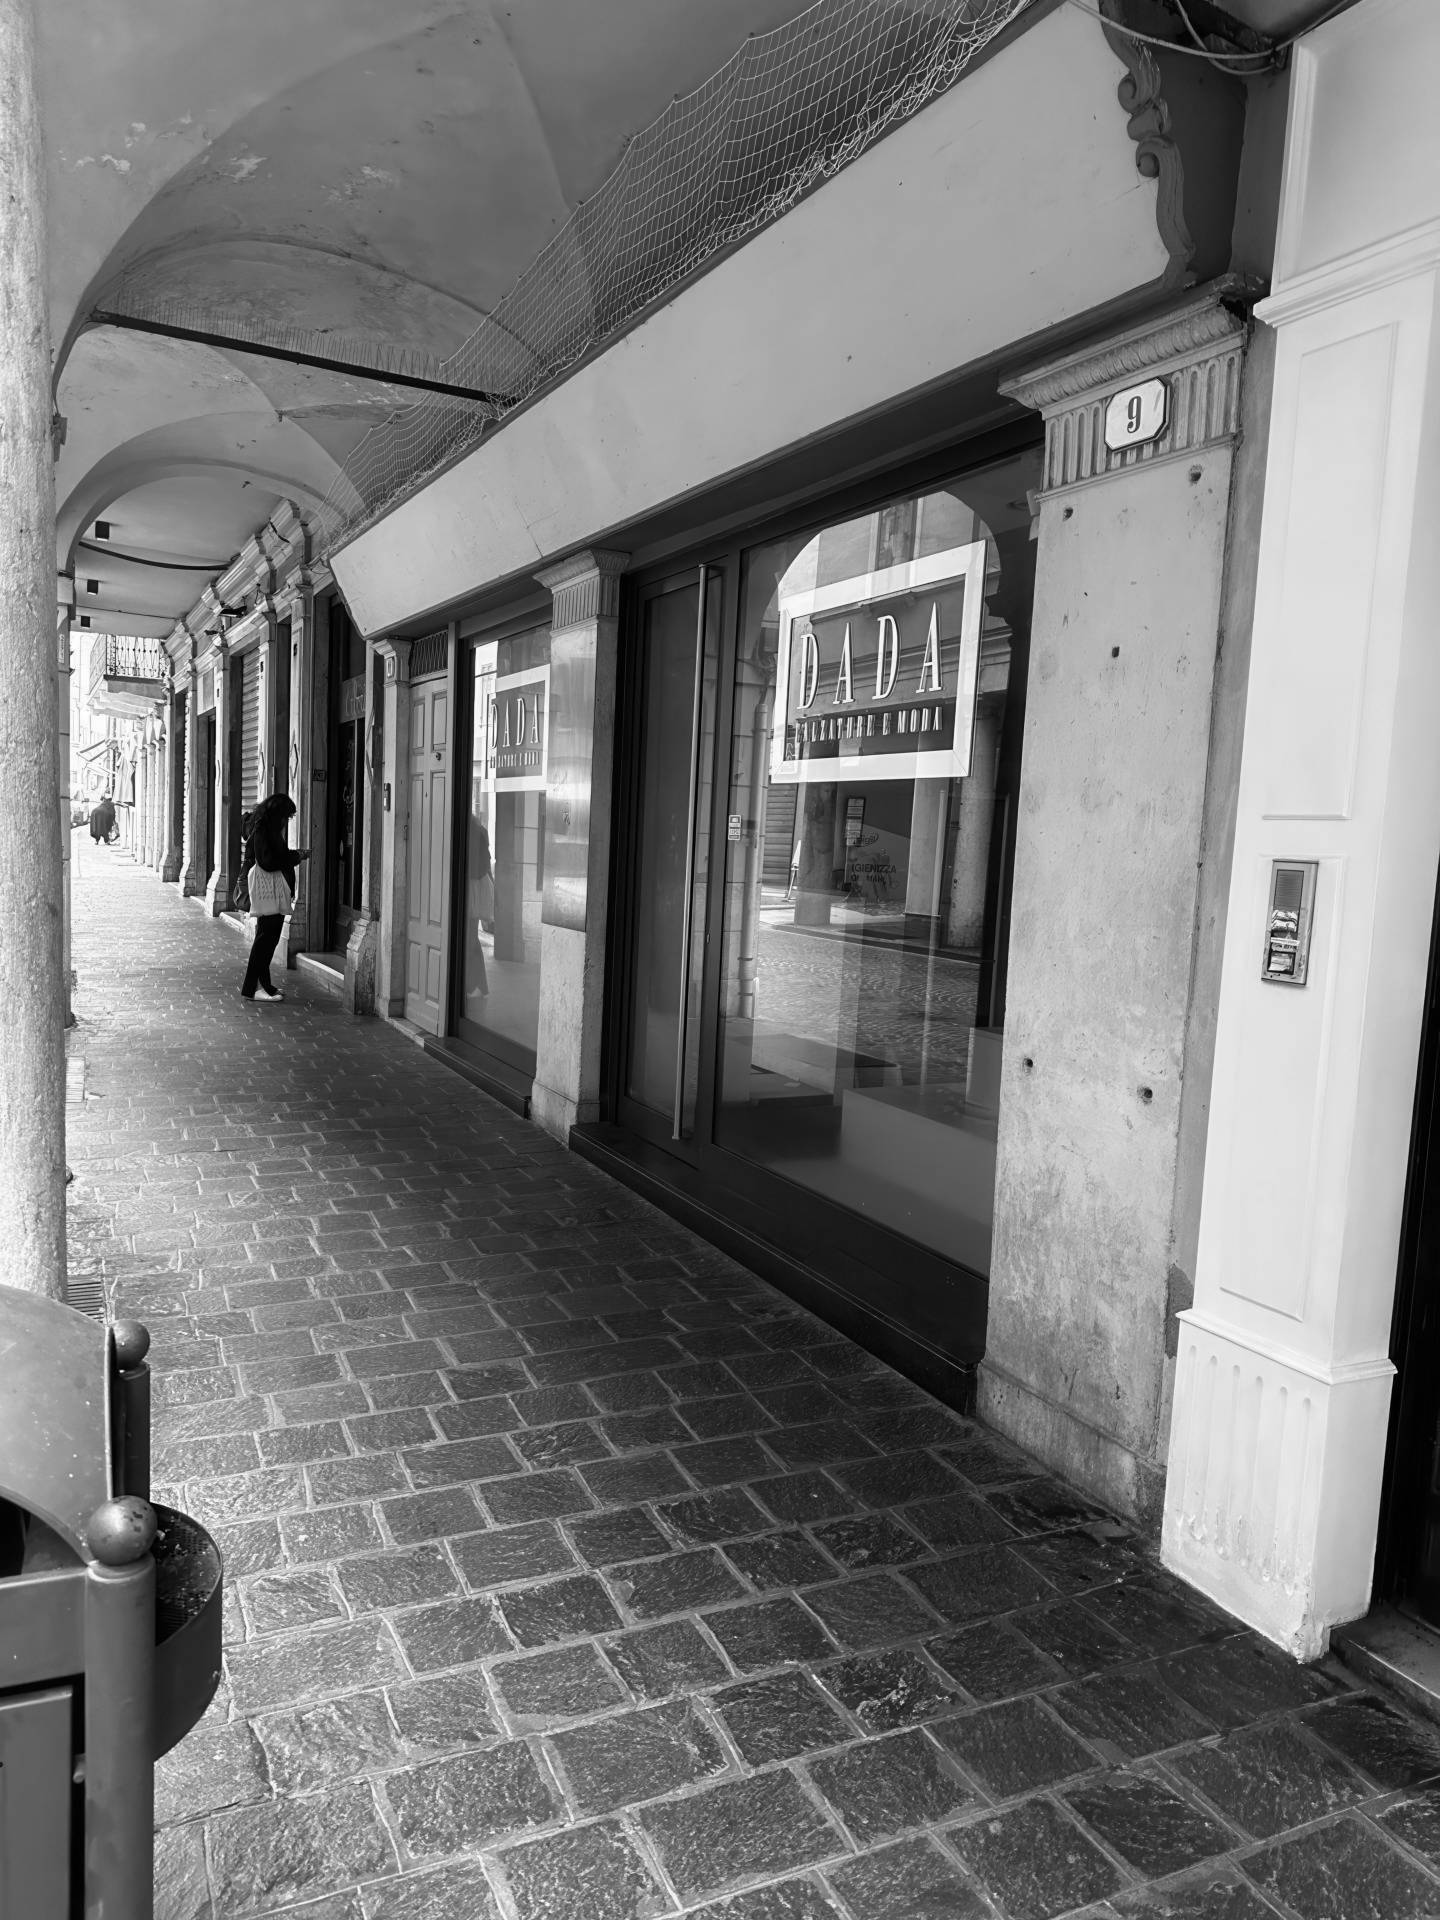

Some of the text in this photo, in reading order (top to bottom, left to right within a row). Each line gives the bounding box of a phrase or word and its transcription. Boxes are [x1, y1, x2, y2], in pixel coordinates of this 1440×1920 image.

[1127, 396, 1142, 433] 9
[797, 601, 942, 709] DADA
[490, 693, 540, 748] DADA
[882, 712, 891, 735] E
[898, 706, 943, 733] MODA
